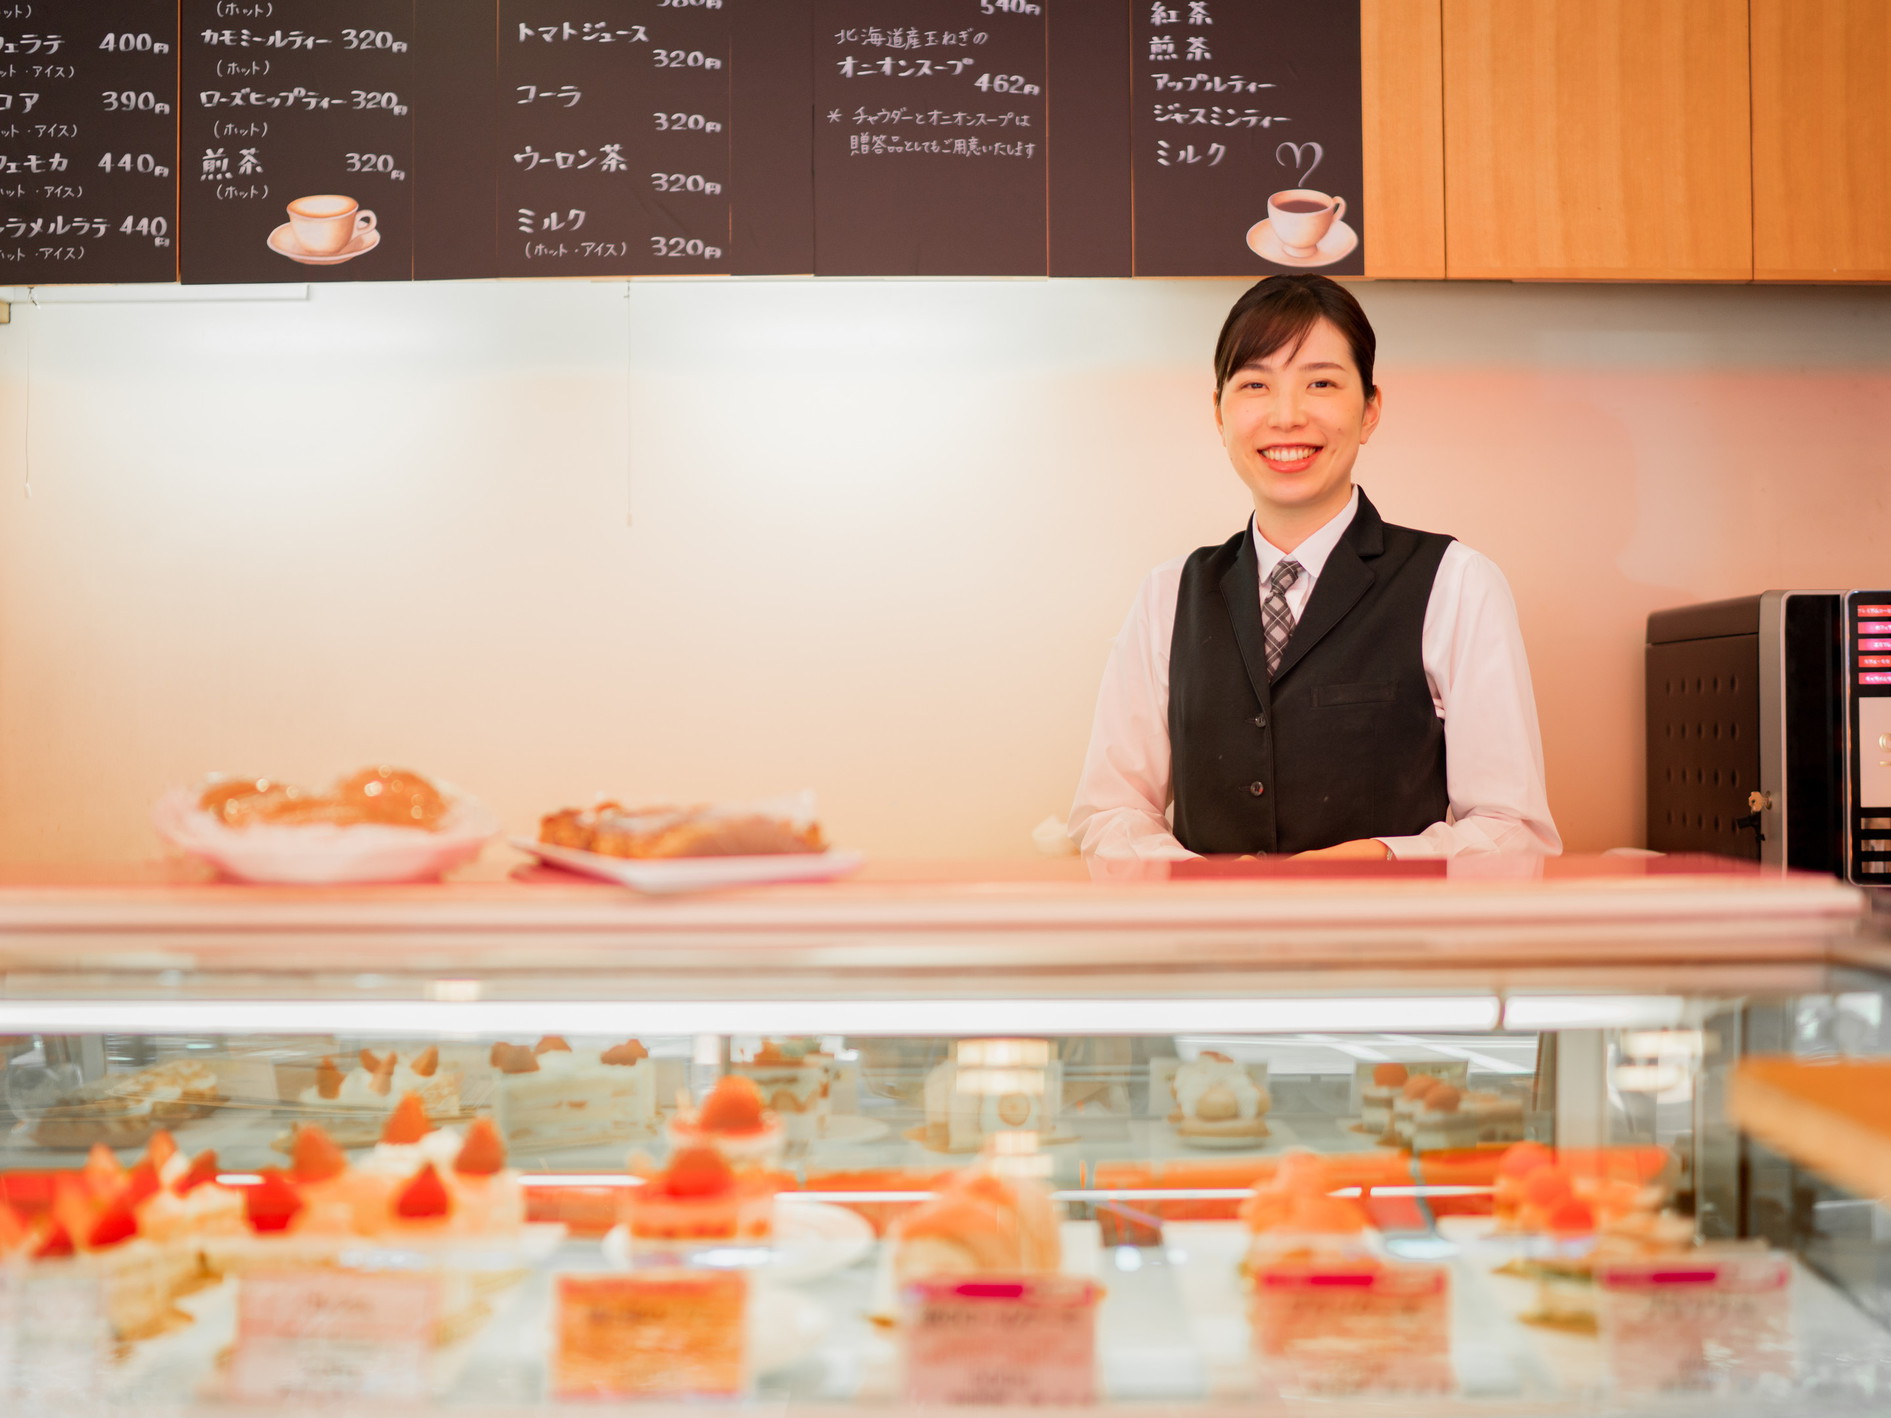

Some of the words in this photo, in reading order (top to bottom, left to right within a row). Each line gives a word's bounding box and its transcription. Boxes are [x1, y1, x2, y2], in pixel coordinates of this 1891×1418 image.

[0, 3, 32, 19] ット)
[216, 0, 273, 18] (ホット)
[1149, 0, 1214, 27] 紅茶
[0, 33, 65, 55] ェラテ
[98, 32, 170, 55] 400円
[200, 28, 333, 51] カモミールティー
[340, 28, 409, 54] 320円
[518, 21, 650, 43] トマトジュース
[833, 26, 989, 51] 北海道産玉ねぎの
[652, 48, 723, 71] 320円
[1148, 34, 1213, 62] 煎茶
[216, 58, 270, 78] (ホット)
[836, 55, 975, 79] オニオンスープ
[973, 72, 1041, 97] 462円
[1150, 72, 1277, 94] アップルティー
[101, 90, 171, 115] 390円
[199, 86, 346, 111] ローズヒップティー
[350, 89, 409, 117] 320円
[516, 84, 582, 108] コーラ
[652, 112, 723, 134] 320円
[851, 105, 1031, 127] チャウダーとオニオンスープは
[1152, 102, 1292, 129] ジャスミンティー
[213, 119, 269, 139] (ホット)
[849, 131, 1036, 159] 贈答品としてもご用意いたします
[1156, 139, 1227, 167] ミルク
[97, 151, 170, 178] 440円
[199, 147, 264, 182] 煎茶
[344, 152, 406, 182] 320円
[513, 143, 629, 173] ウーロン茶
[0, 183, 83, 199] ット・アイス)
[216, 183, 269, 201] (ホット)
[650, 172, 722, 196] 320円
[0, 214, 111, 239] ラメルラテ
[118, 214, 171, 248] 440円
[517, 208, 587, 234] ミルク
[0, 245, 85, 262] ット・アイス)
[650, 235, 723, 260] 320円
